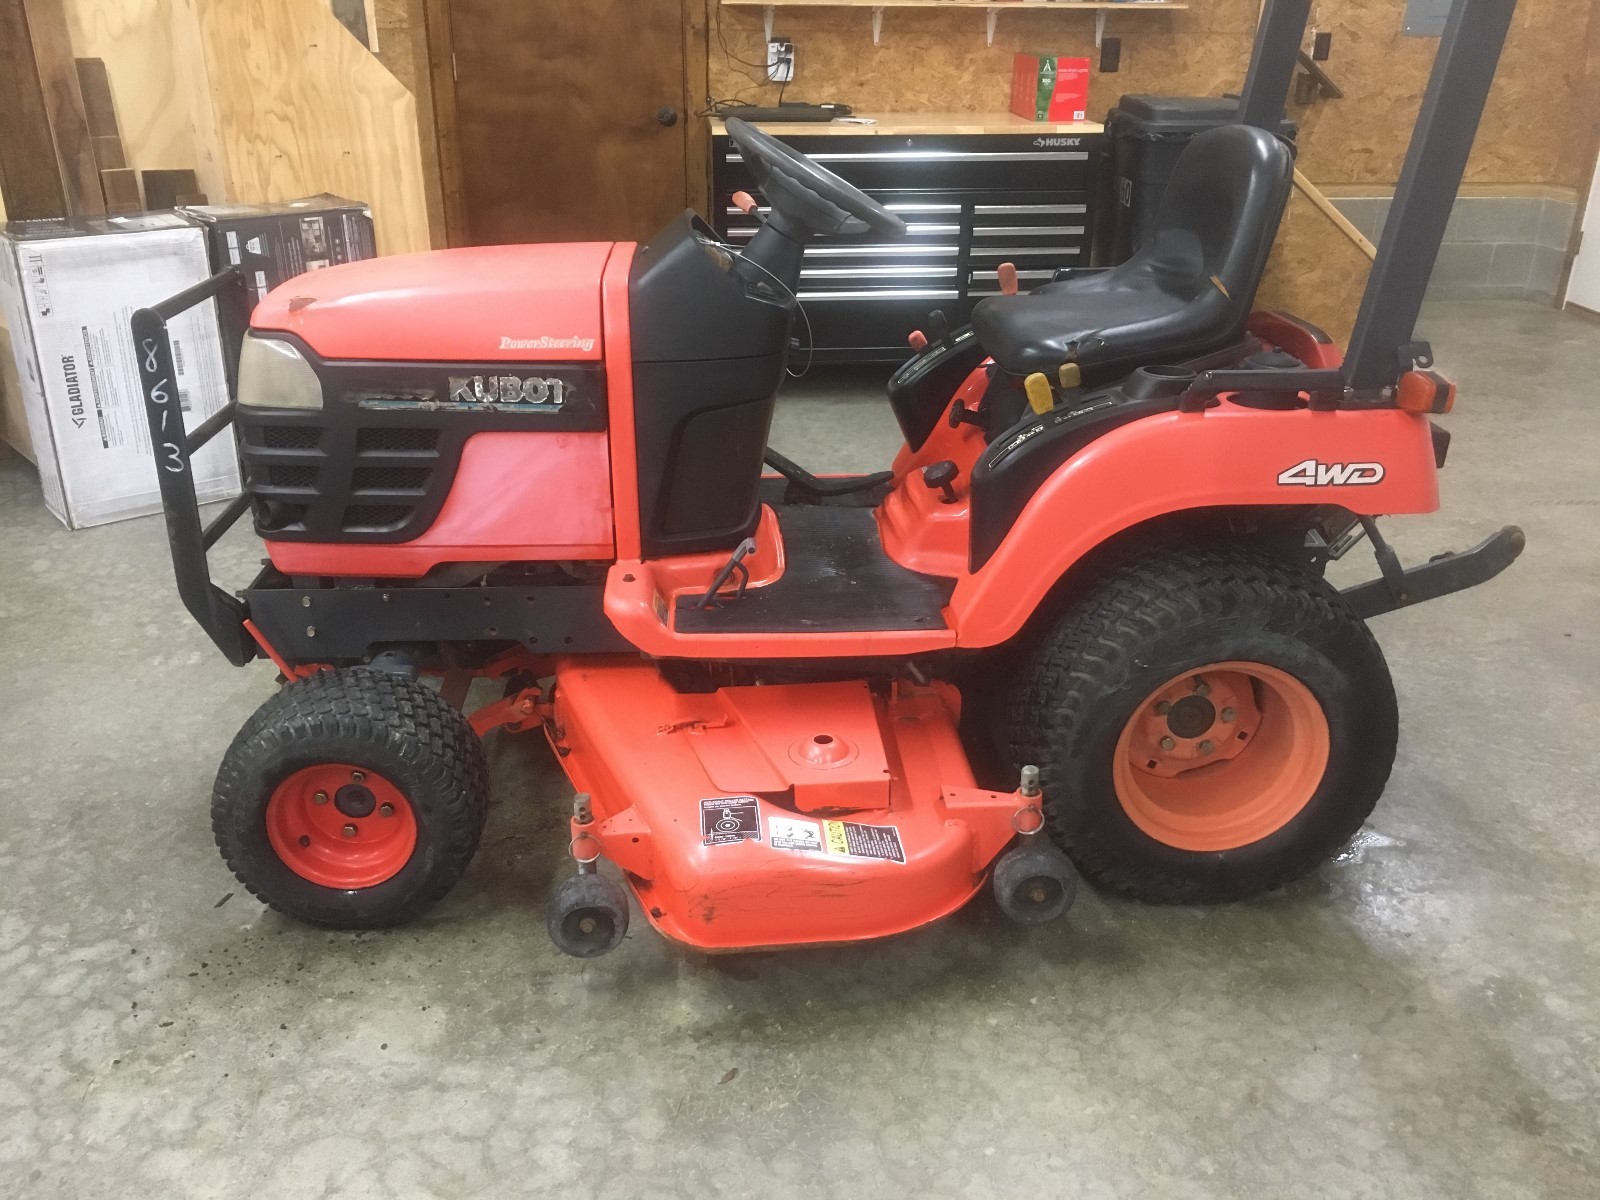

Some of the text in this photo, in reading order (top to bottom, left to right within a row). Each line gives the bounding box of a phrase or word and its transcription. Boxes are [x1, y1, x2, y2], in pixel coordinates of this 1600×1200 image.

[1045, 137, 1080, 146] HUSKY
[62, 354, 85, 416] GLADIATOR
[1277, 459, 1385, 487] 4WD
[828, 821, 844, 844] CAUTIO
